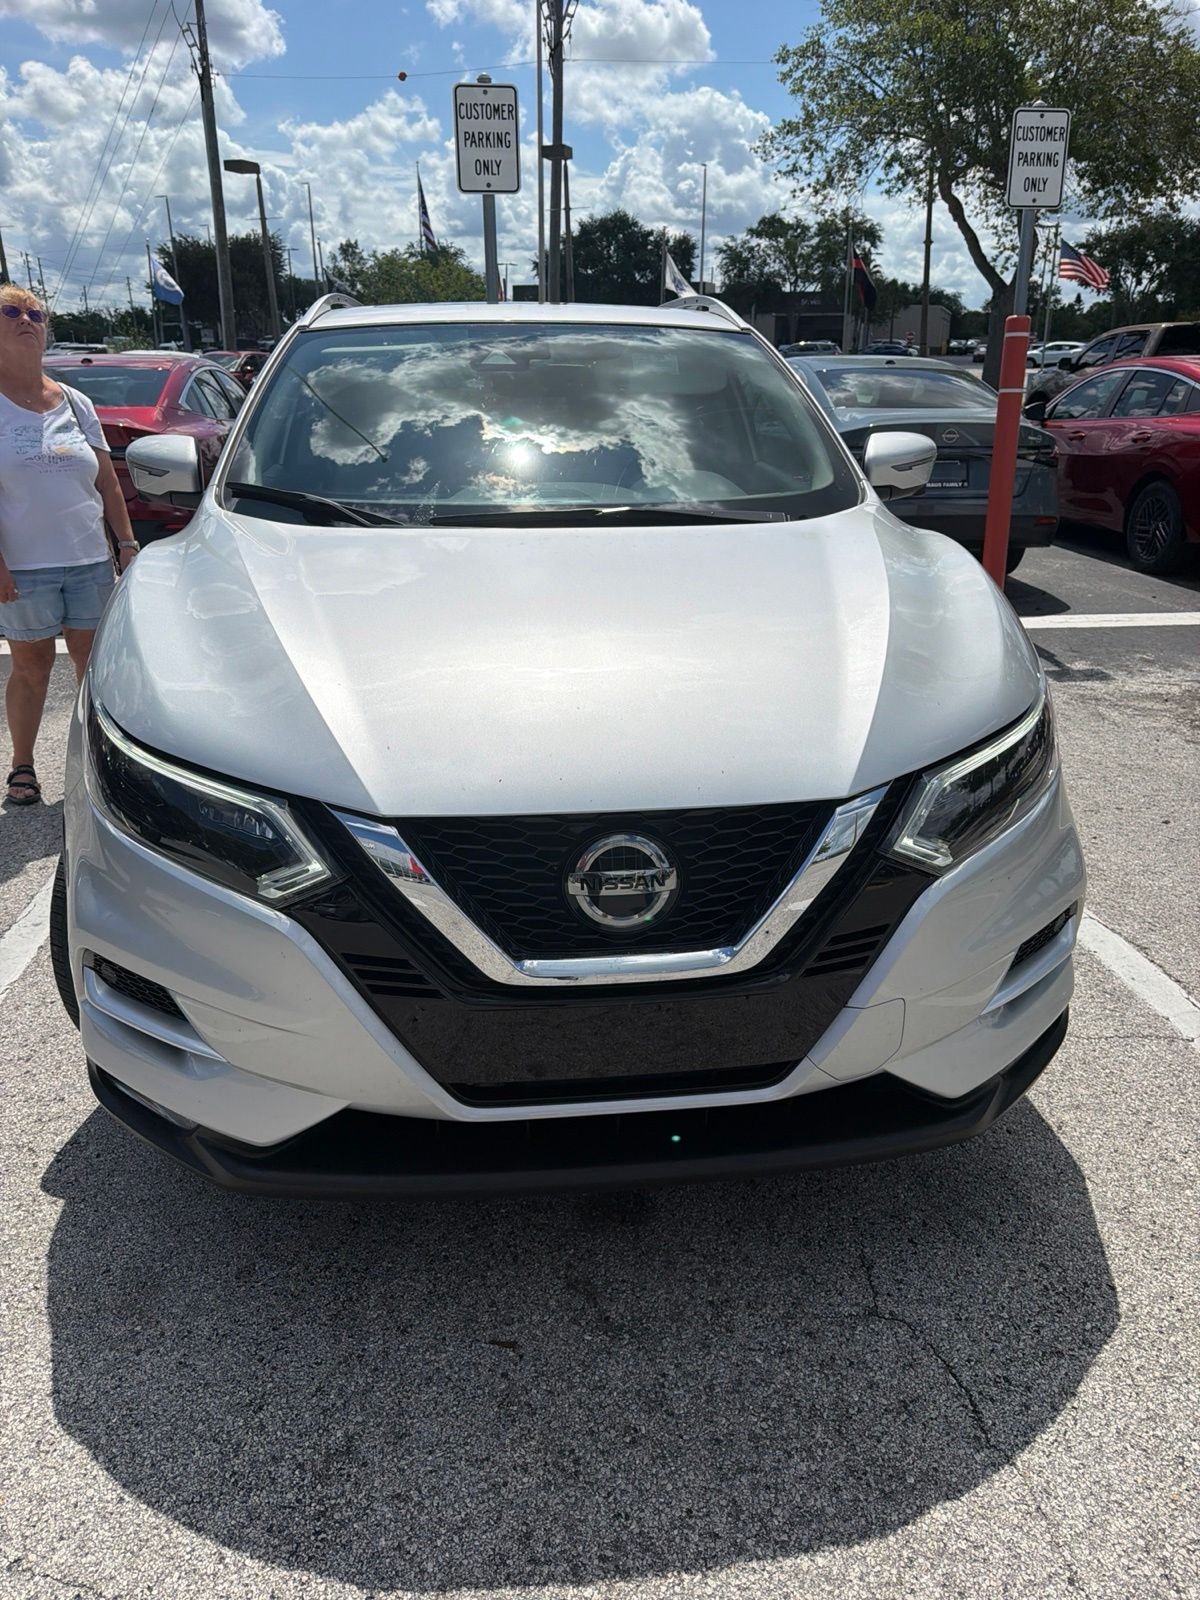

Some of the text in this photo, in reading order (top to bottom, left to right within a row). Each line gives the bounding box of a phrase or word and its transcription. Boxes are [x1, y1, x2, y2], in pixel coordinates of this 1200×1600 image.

[459, 102, 514, 120] CUSTOMER
[464, 131, 511, 149] PARKING
[1016, 126, 1065, 142] CUSTOMER
[475, 158, 502, 176] ONLY
[1017, 151, 1059, 168] PARKING
[1023, 176, 1049, 193] ONLY
[580, 872, 667, 892] NISSAN
